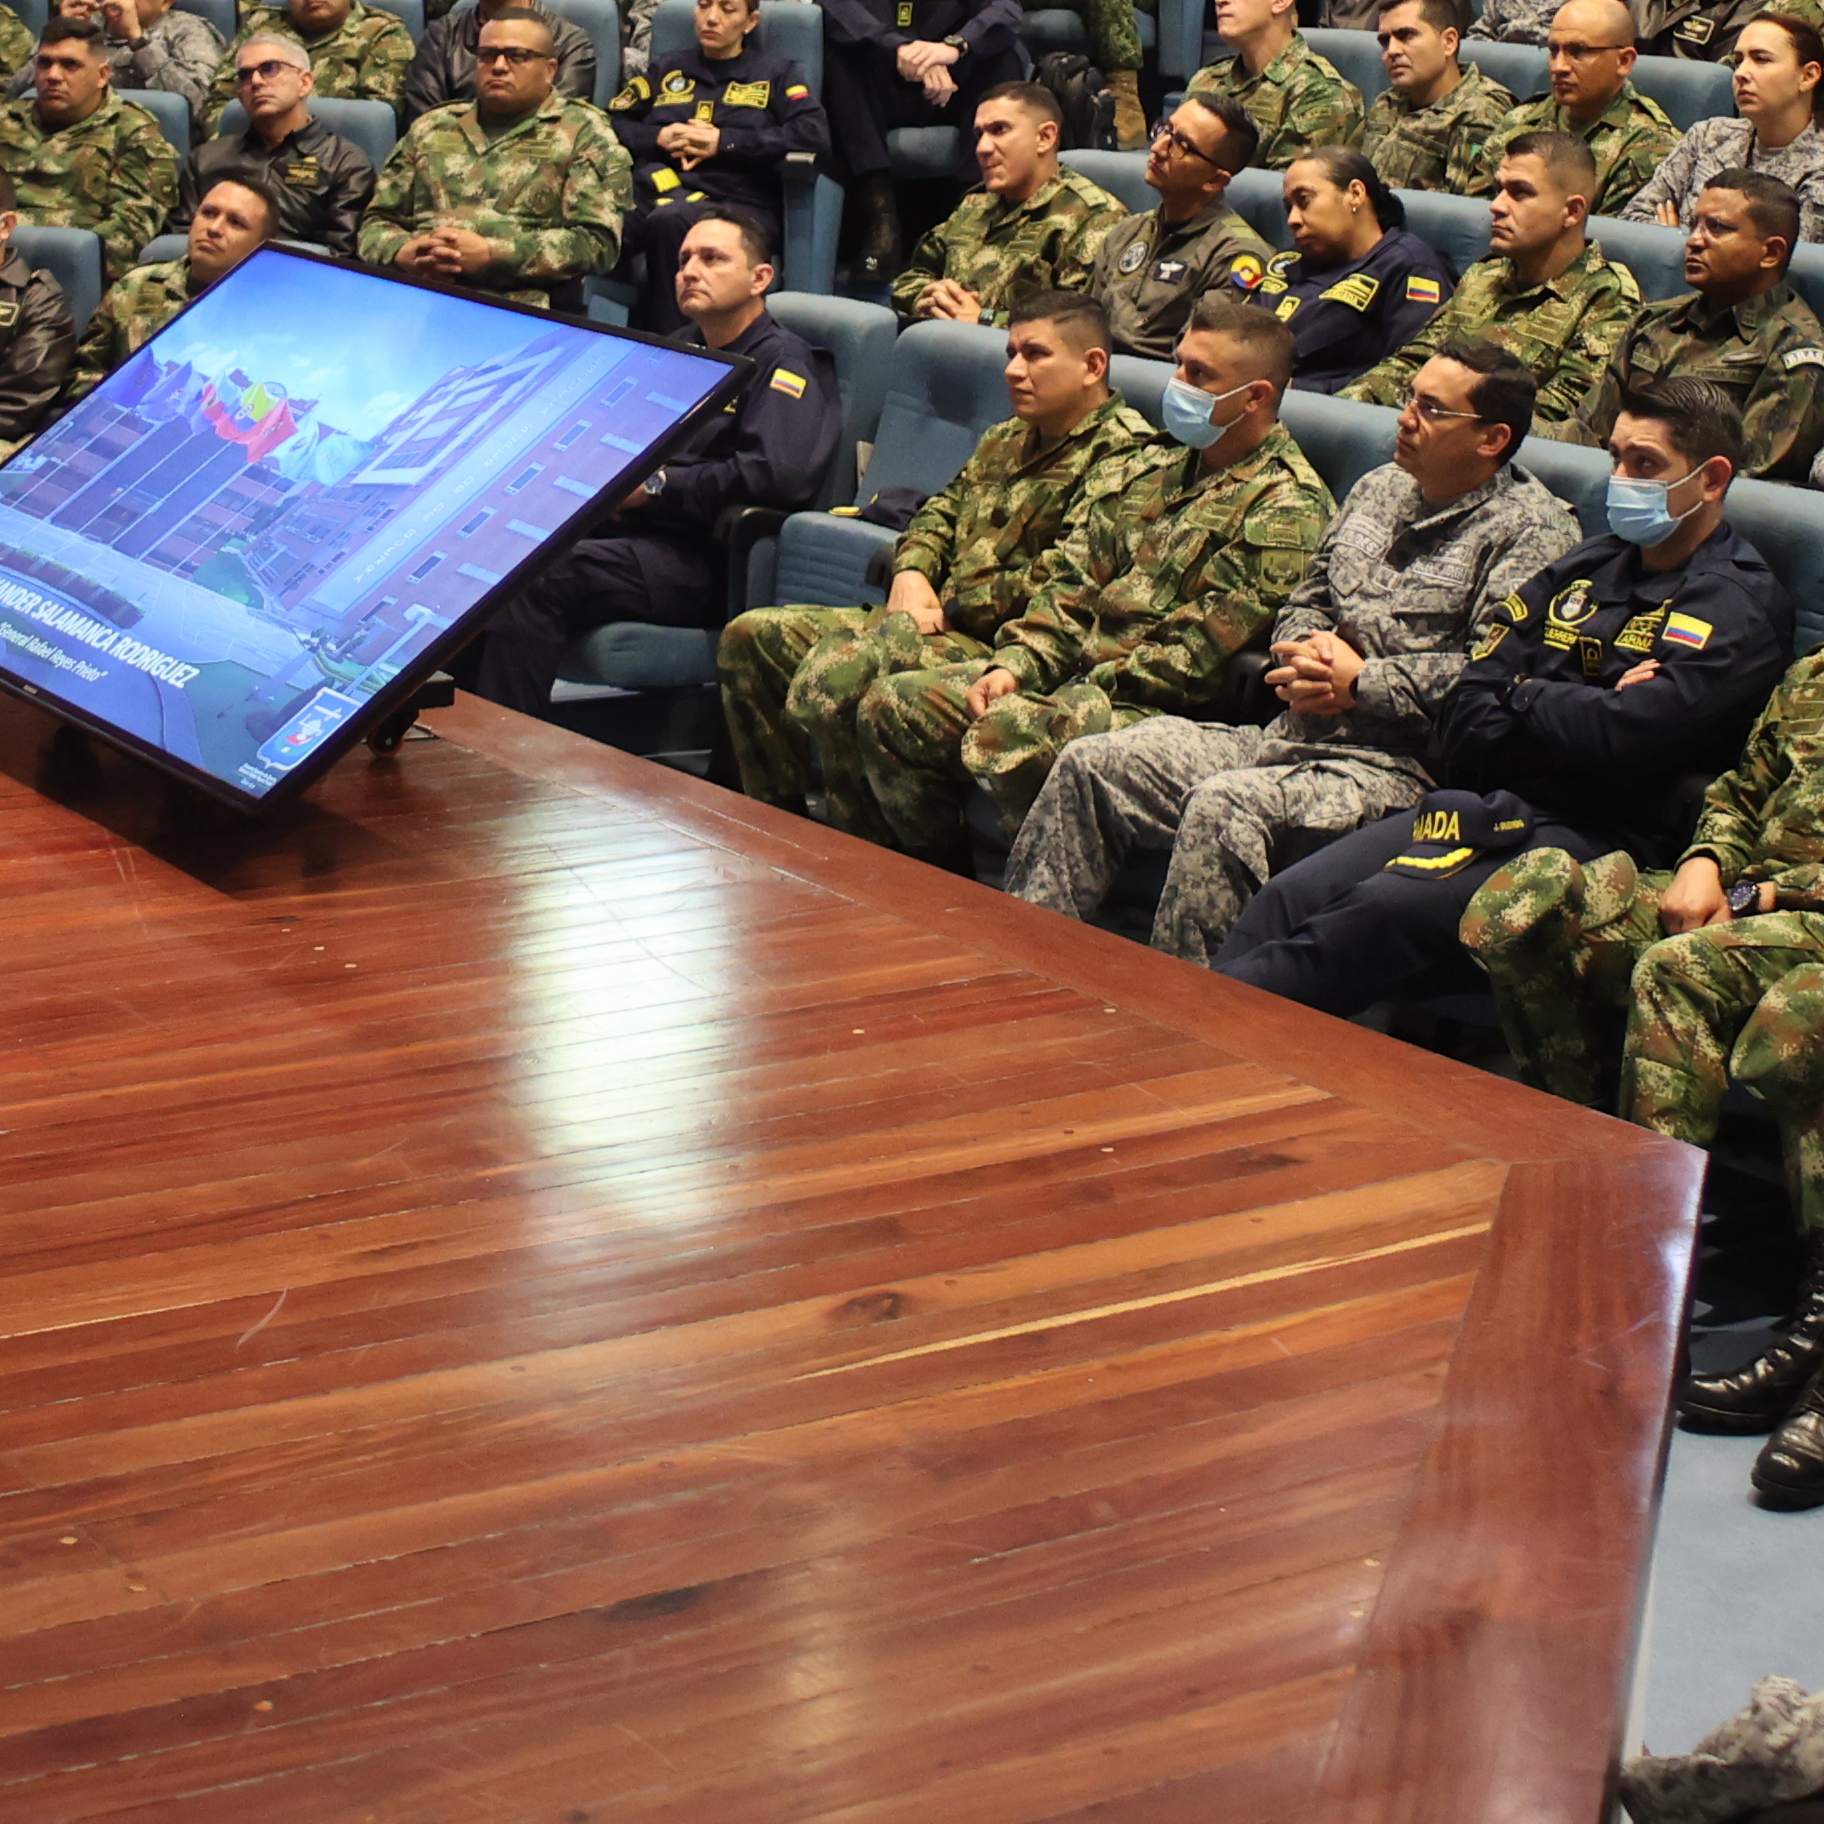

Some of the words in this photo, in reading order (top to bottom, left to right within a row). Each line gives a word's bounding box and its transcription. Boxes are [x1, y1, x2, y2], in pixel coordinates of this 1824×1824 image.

[25, 636, 58, 660] Rafael
[50, 646, 77, 673] Reyes
[71, 660, 109, 682] Prieto"
[31, 600, 121, 652] SALAMANCA
[108, 637, 201, 689] RODRIGUEZ
